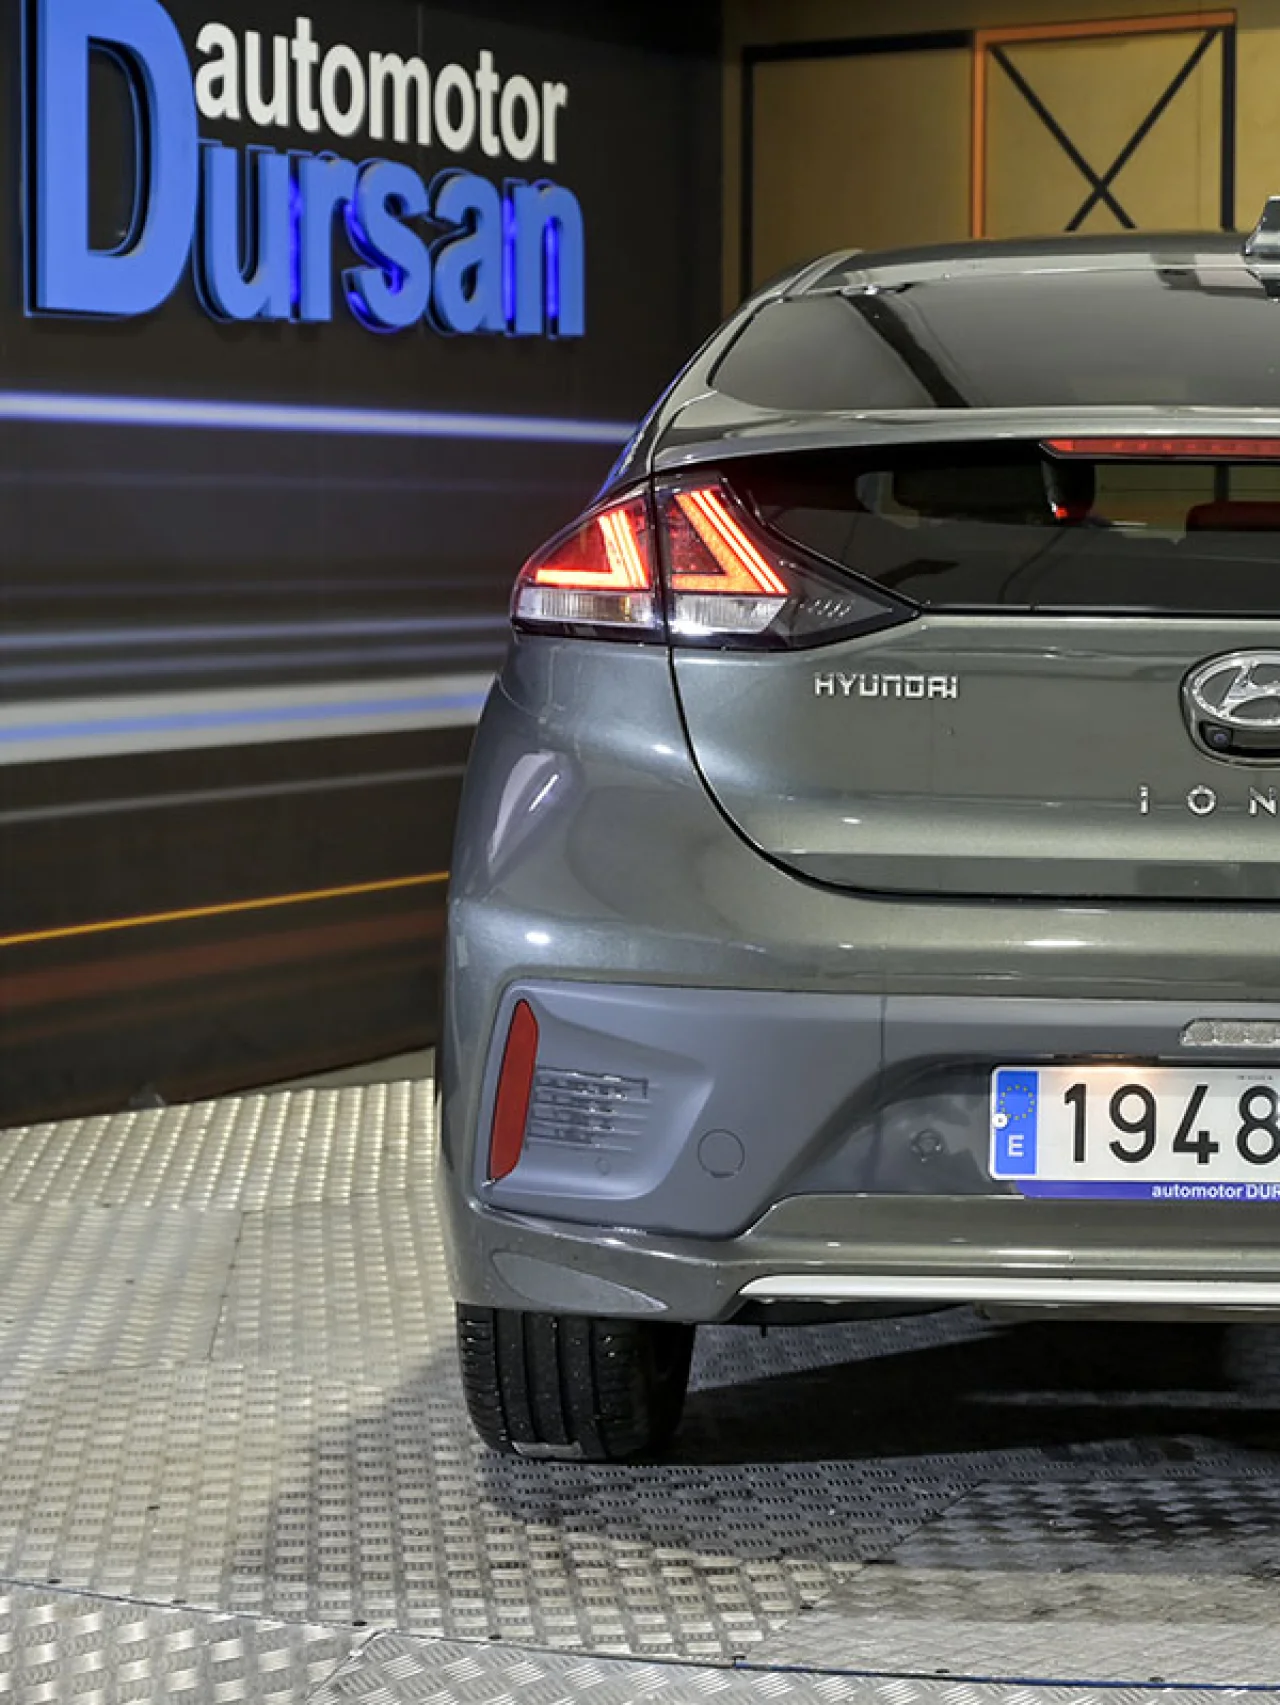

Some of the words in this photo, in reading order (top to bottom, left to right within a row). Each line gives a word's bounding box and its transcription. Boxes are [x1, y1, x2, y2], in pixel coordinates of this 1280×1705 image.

[194, 16, 568, 163] automotor
[23, 0, 586, 338] Dursan
[813, 672, 959, 699] HYUNDAI
[1007, 1134, 1025, 1158] E
[1151, 1183, 1243, 1199] automotor
